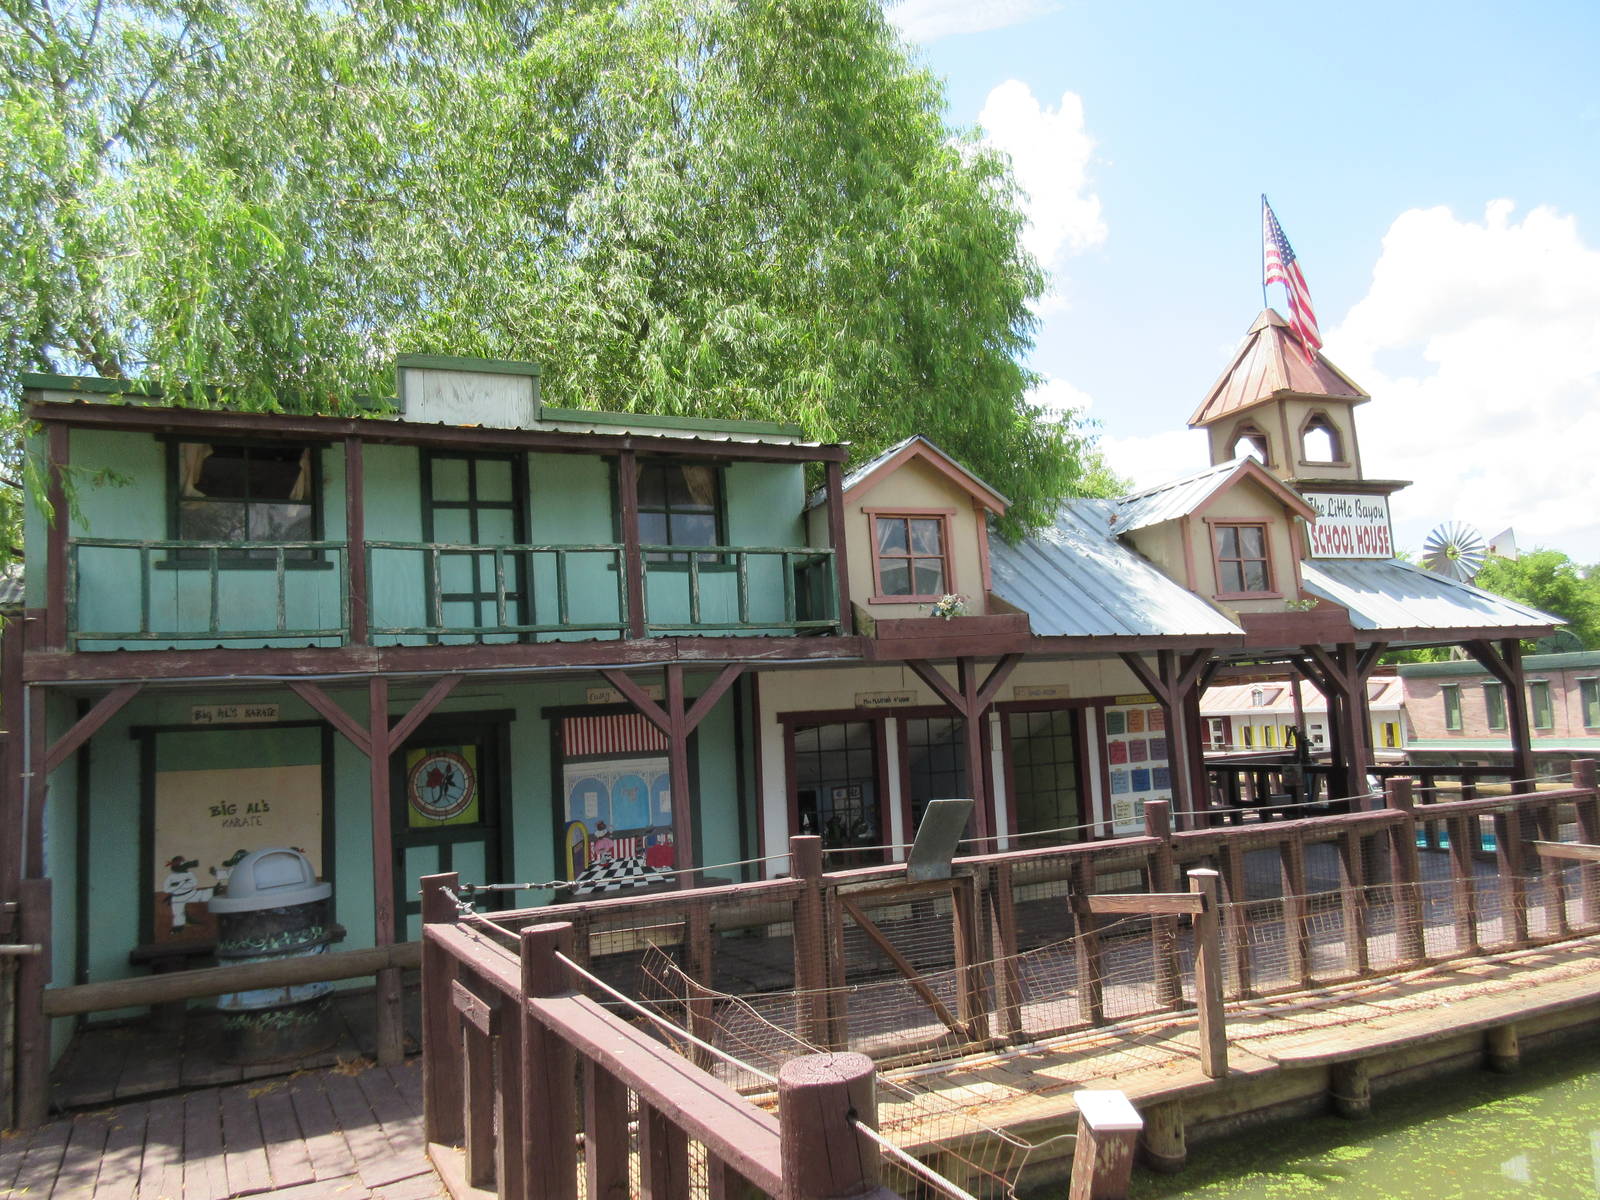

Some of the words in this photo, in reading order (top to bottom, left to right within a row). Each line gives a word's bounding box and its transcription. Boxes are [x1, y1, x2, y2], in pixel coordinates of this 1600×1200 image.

[1307, 497, 1325, 517] The
[1327, 497, 1353, 519] Little
[1355, 498, 1384, 523] Bayou
[1311, 524, 1354, 554] SCHOOL
[1355, 525, 1390, 555] HOUSE
[222, 816, 263, 828] KARATE
